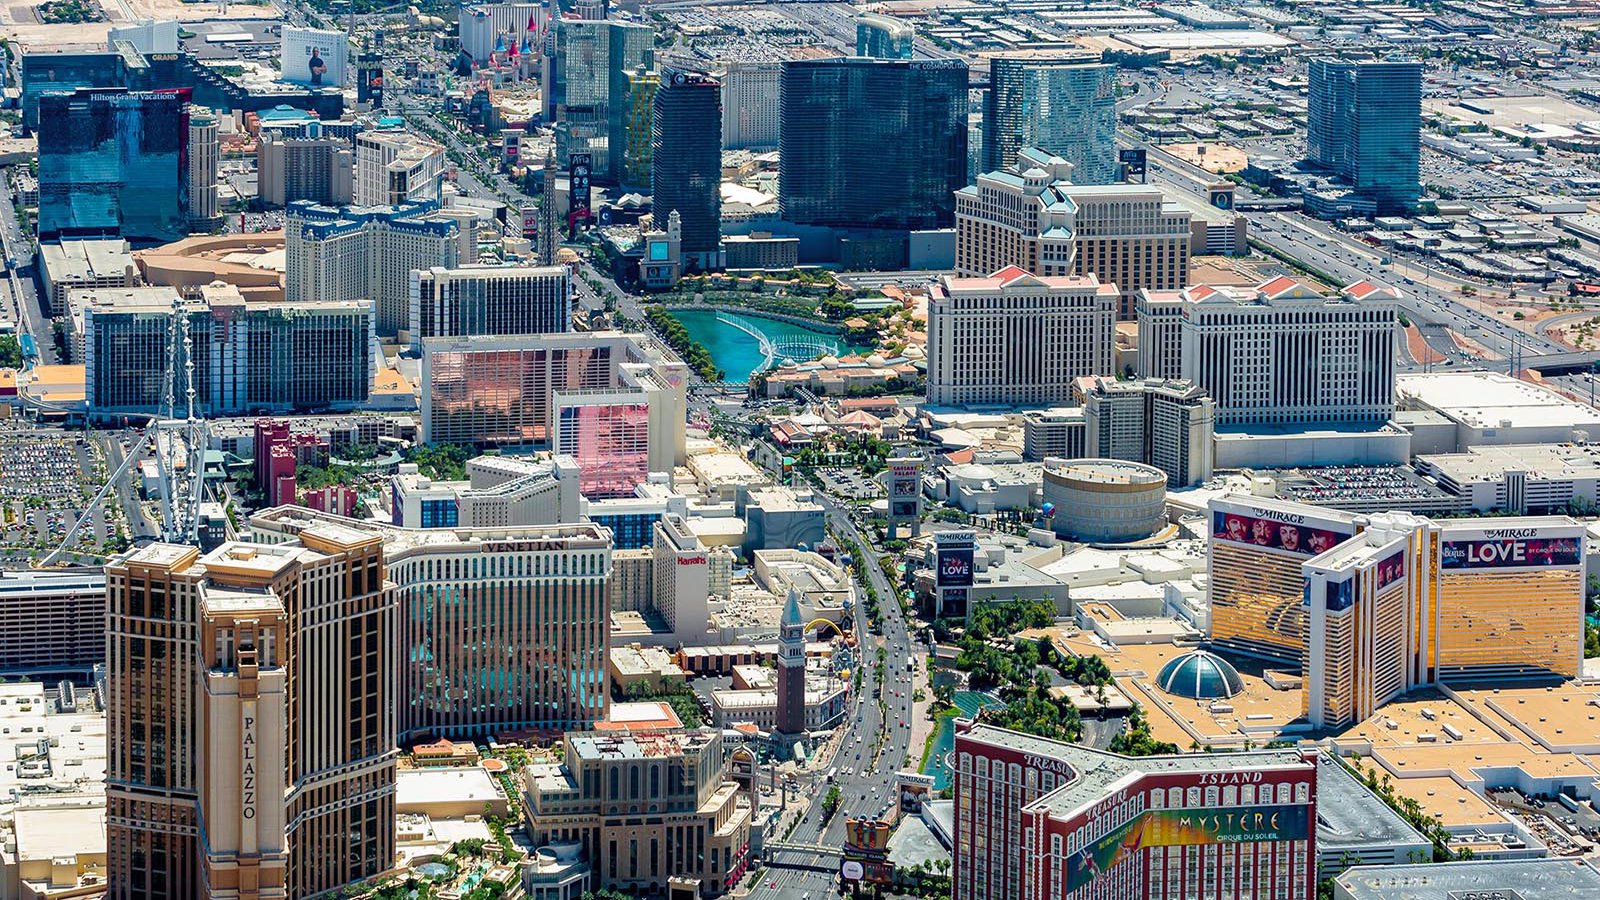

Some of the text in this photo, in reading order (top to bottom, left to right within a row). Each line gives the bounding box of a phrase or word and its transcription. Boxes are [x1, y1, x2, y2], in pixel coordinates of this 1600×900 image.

[922, 62, 969, 70] COSMOPOLITAN
[90, 92, 176, 101] Hilton Grand Vacations
[1257, 509, 1305, 524] MIRAGE
[944, 533, 975, 541] MIRAGE
[1489, 529, 1537, 538] MIRAGE
[486, 541, 564, 552] VENETIAN
[1468, 543, 1526, 562] LOVE
[942, 566, 968, 575] LOVE
[243, 717, 255, 819] PALAZZO
[1199, 772, 1263, 784] ISLAND
[1085, 788, 1128, 820] TREASURE
[1178, 809, 1280, 833] MYSTÈRE
[1255, 832, 1279, 840] SOLEIL
